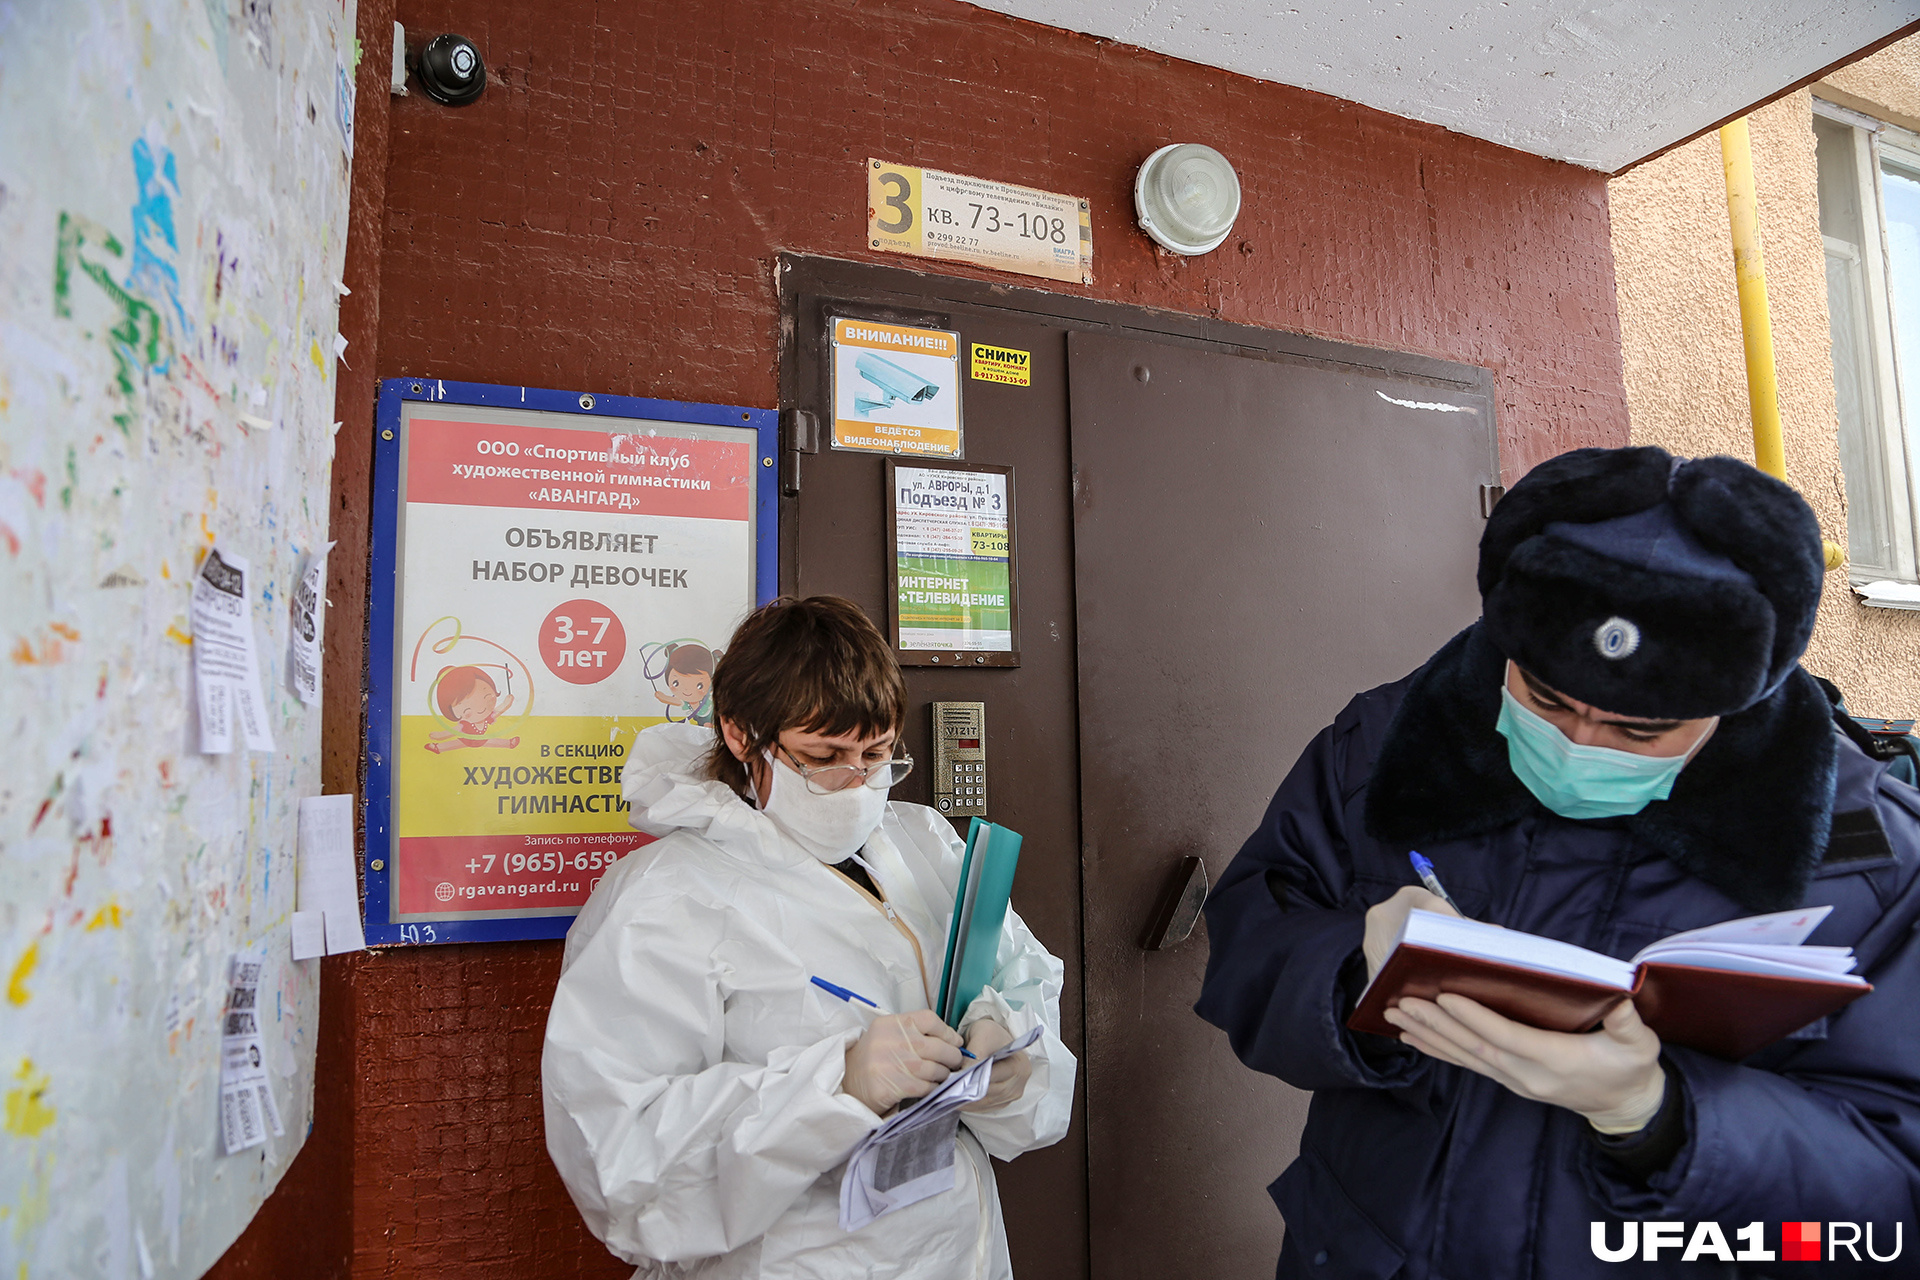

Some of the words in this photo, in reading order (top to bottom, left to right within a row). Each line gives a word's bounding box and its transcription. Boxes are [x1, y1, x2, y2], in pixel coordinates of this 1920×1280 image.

[926, 172, 955, 184] Подъезд
[956, 178, 994, 190] подключен
[1001, 186, 1040, 200] Проводному
[1042, 192, 1076, 207] Интернету
[876, 172, 914, 234] 3
[986, 193, 1030, 206] телевидению
[968, 202, 1066, 245] 73-108
[937, 232, 954, 243] 299
[956, 235, 968, 245] 22
[968, 236, 980, 247] 77
[845, 327, 948, 351] ВНИМАНИЕ!!!
[975, 347, 1028, 365] СНИМУ
[844, 436, 950, 452] ВИДЕОНАБЛЮДЕНИЕ
[477, 440, 520, 457] ООО
[524, 444, 646, 466] «Спортивный
[649, 450, 690, 468] клуб
[452, 463, 606, 486] художественной
[609, 473, 711, 492] гимнастики
[912, 480, 925, 490] ул.
[928, 480, 973, 495] АВРОРЫ,
[528, 486, 641, 508] «АВАНГАРД»
[901, 488, 968, 510] Подъезд
[973, 496, 986, 509] №
[991, 493, 1001, 510] 3
[504, 526, 659, 554] ОБЪЯВЛЯЕТ
[972, 541, 1010, 551] 73-108
[472, 560, 564, 584] НАБОР
[570, 564, 689, 590] ДЕВОЧЕК
[900, 576, 969, 590] ИНТЕРНЕТ
[900, 590, 1005, 607] +ТЕЛЕВИДЕНИЕ
[554, 616, 611, 644] 3-7
[556, 650, 608, 668] лет
[946, 727, 977, 735] VIZIT
[540, 744, 551, 758] В
[554, 744, 624, 760] СЕКЦИЮ
[524, 836, 564, 846] Запись
[566, 836, 580, 846] по
[582, 834, 638, 848] телефону:
[465, 854, 497, 874] +7
[458, 880, 580, 898] rgavangard.ru
